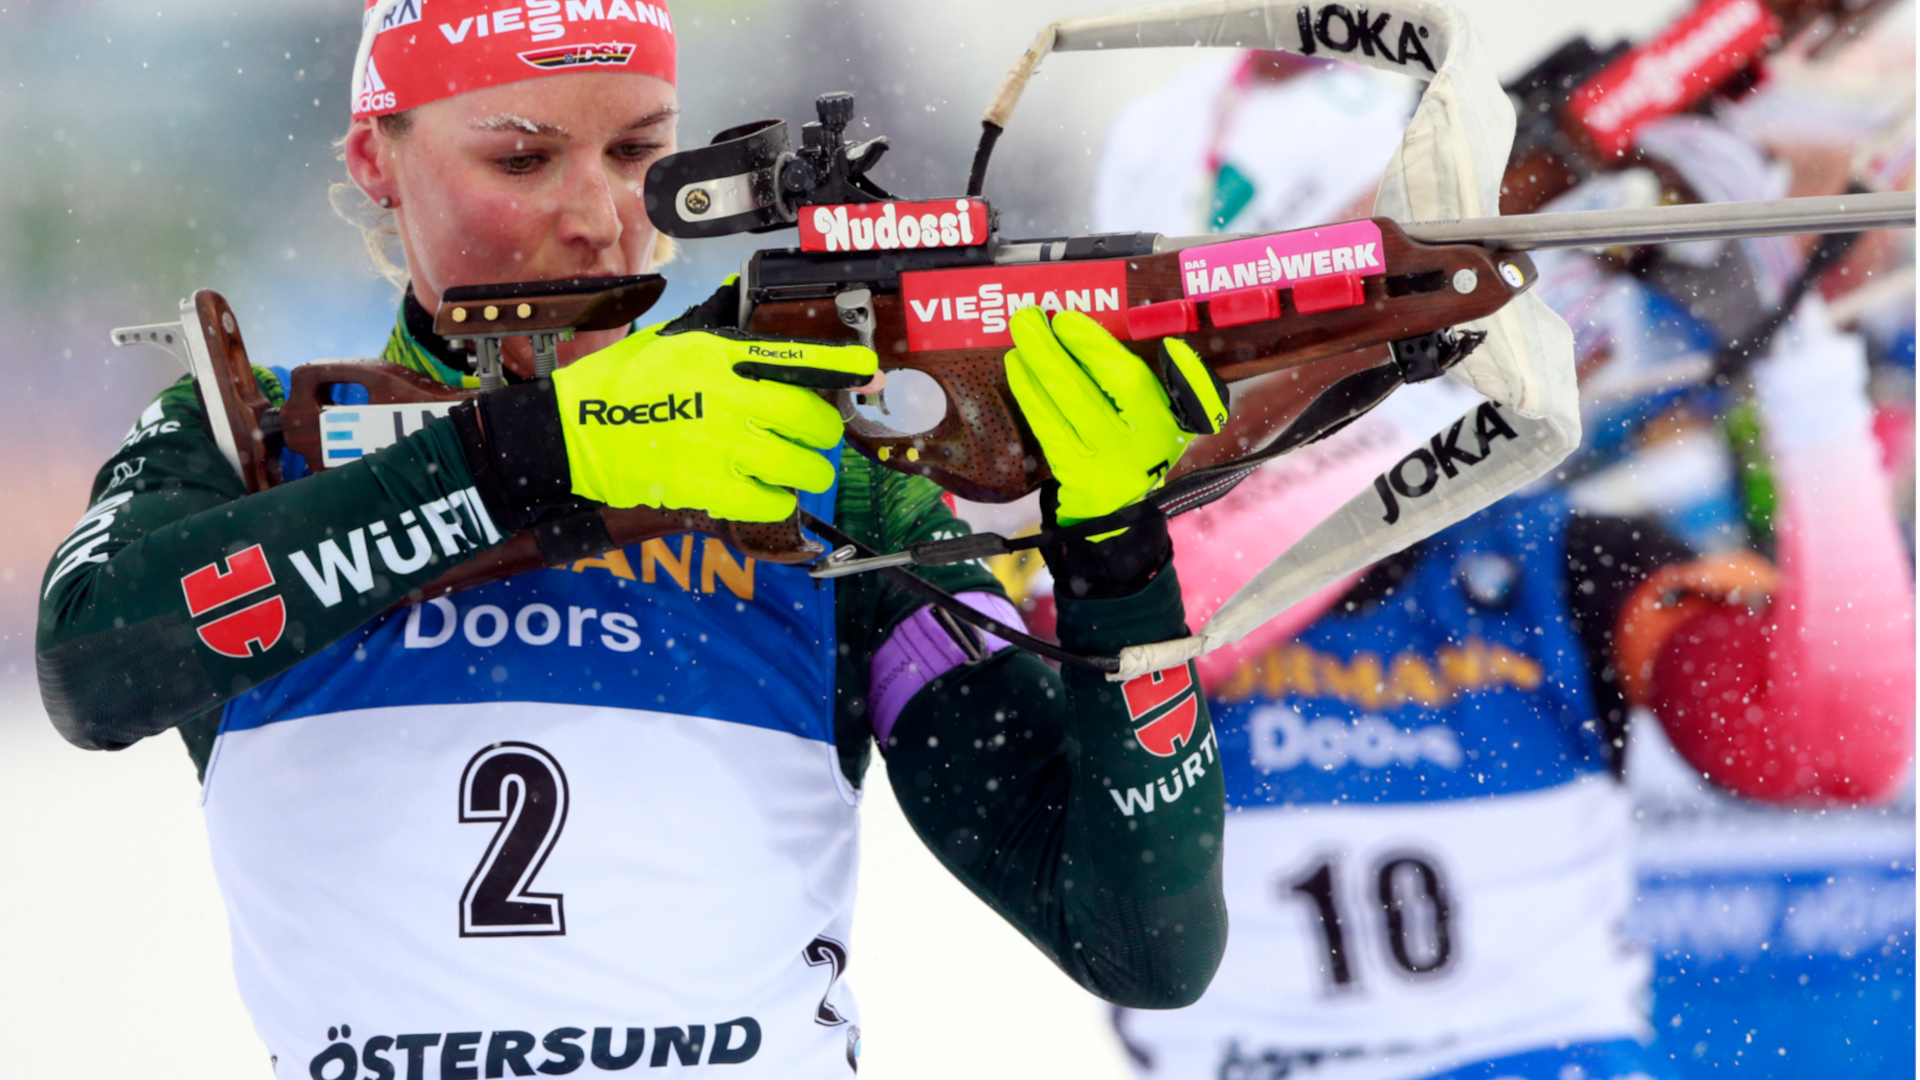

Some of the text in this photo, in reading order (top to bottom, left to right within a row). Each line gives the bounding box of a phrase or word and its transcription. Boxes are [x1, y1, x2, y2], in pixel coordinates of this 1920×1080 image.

[438, 0, 673, 44] VIESSMANN
[1297, 3, 1437, 73] JOKA
[813, 198, 974, 252] Nudossi
[1184, 259, 1207, 270] DAS
[909, 283, 1119, 333] VIESSMANN
[1374, 401, 1519, 525] JOKA
[404, 597, 642, 652] Doors
[458, 741, 570, 938] 2
[1276, 846, 1460, 1000] 10
[801, 933, 849, 1027] 2
[309, 1016, 762, 1080] ÖSTERSUND
